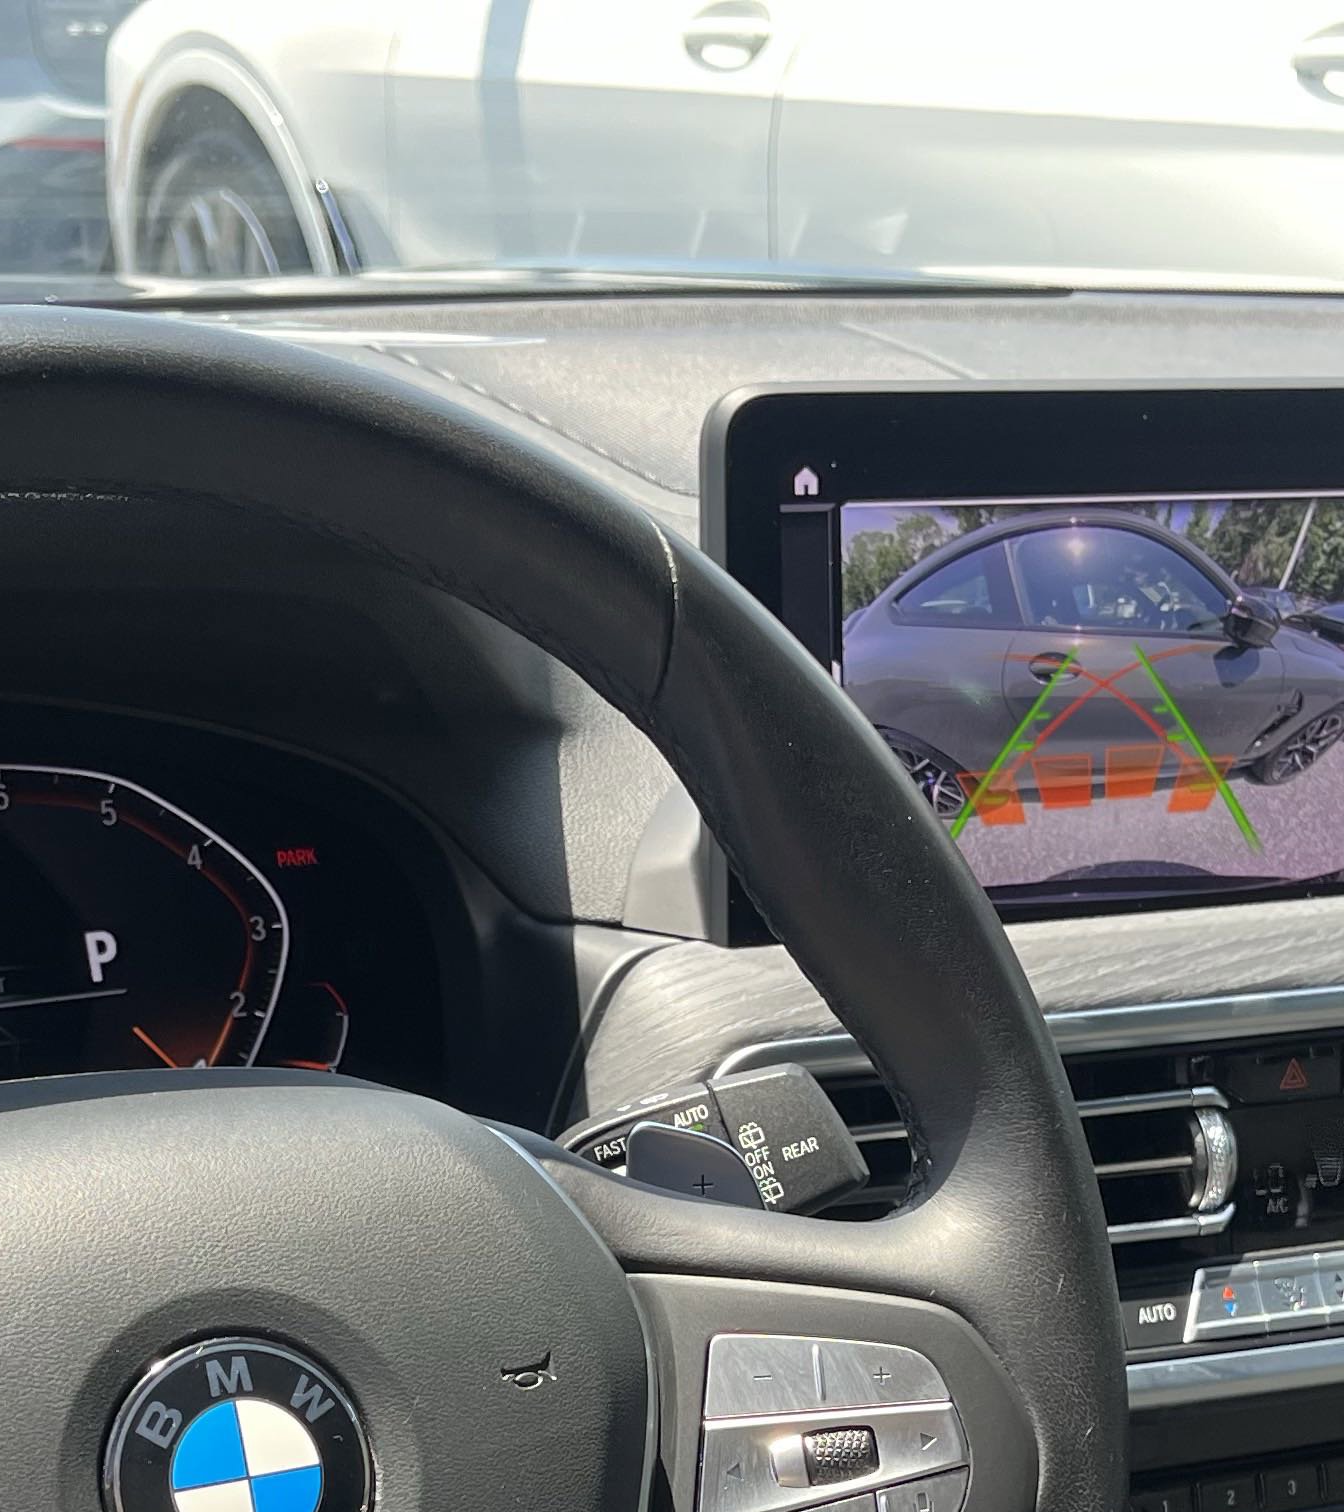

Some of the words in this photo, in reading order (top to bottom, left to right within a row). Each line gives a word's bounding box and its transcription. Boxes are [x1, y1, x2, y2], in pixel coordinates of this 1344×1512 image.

[99, 800, 117, 827] 5
[186, 844, 204, 870] 4
[276, 848, 318, 868] PARK
[250, 916, 267, 941] 3
[84, 931, 117, 983] P
[229, 992, 248, 1018] 2
[673, 1104, 709, 1129] AUTO
[594, 1137, 627, 1163] FAST
[745, 1146, 771, 1168] OFF
[782, 1136, 820, 1162] REAR
[753, 1162, 775, 1181] ON
[1138, 1302, 1177, 1325] AUTO
[135, 1356, 334, 1449] BMW
[1226, 1488, 1235, 1506] 2
[1287, 1479, 1296, 1496] 3
